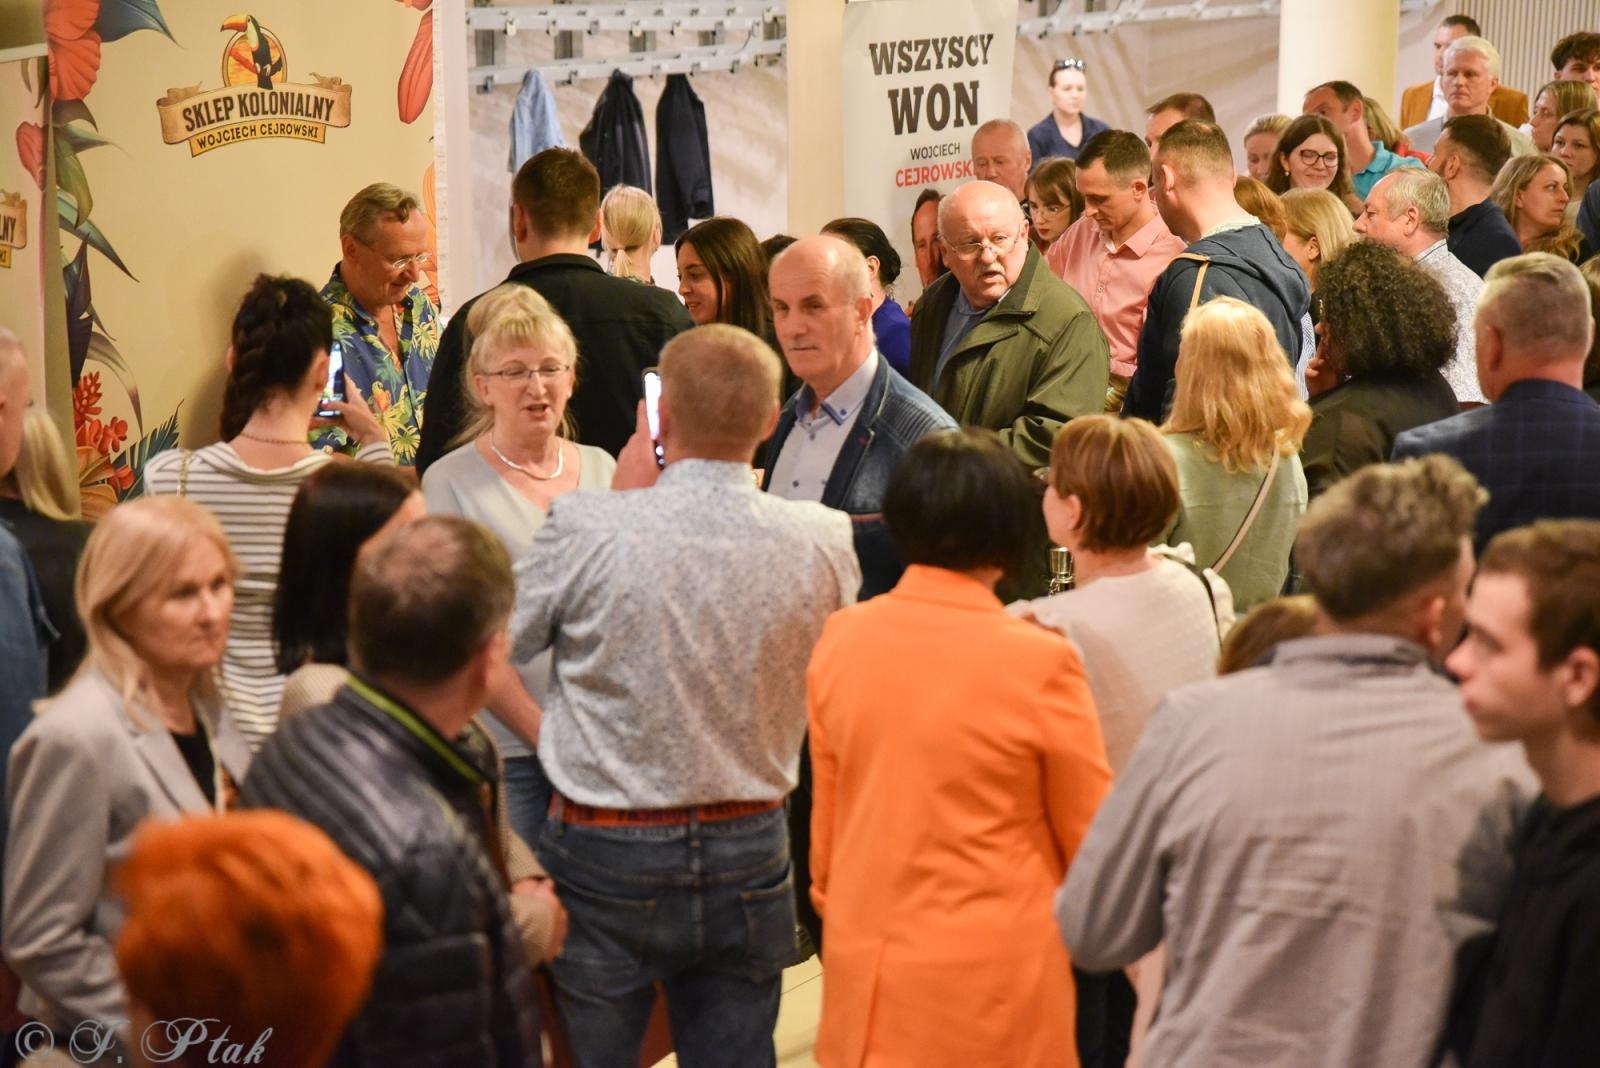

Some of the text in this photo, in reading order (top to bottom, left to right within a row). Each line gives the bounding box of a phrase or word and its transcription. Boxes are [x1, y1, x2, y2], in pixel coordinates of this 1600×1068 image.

[868, 33, 994, 76] WSZYSCY
[182, 91, 335, 132] SKLEP KOLONIALNY
[887, 80, 980, 136] WON
[196, 123, 319, 150] WOJCIECH CEJROWSKI
[909, 142, 961, 161] WOJCIECH
[895, 159, 974, 188] CEJROWSK
